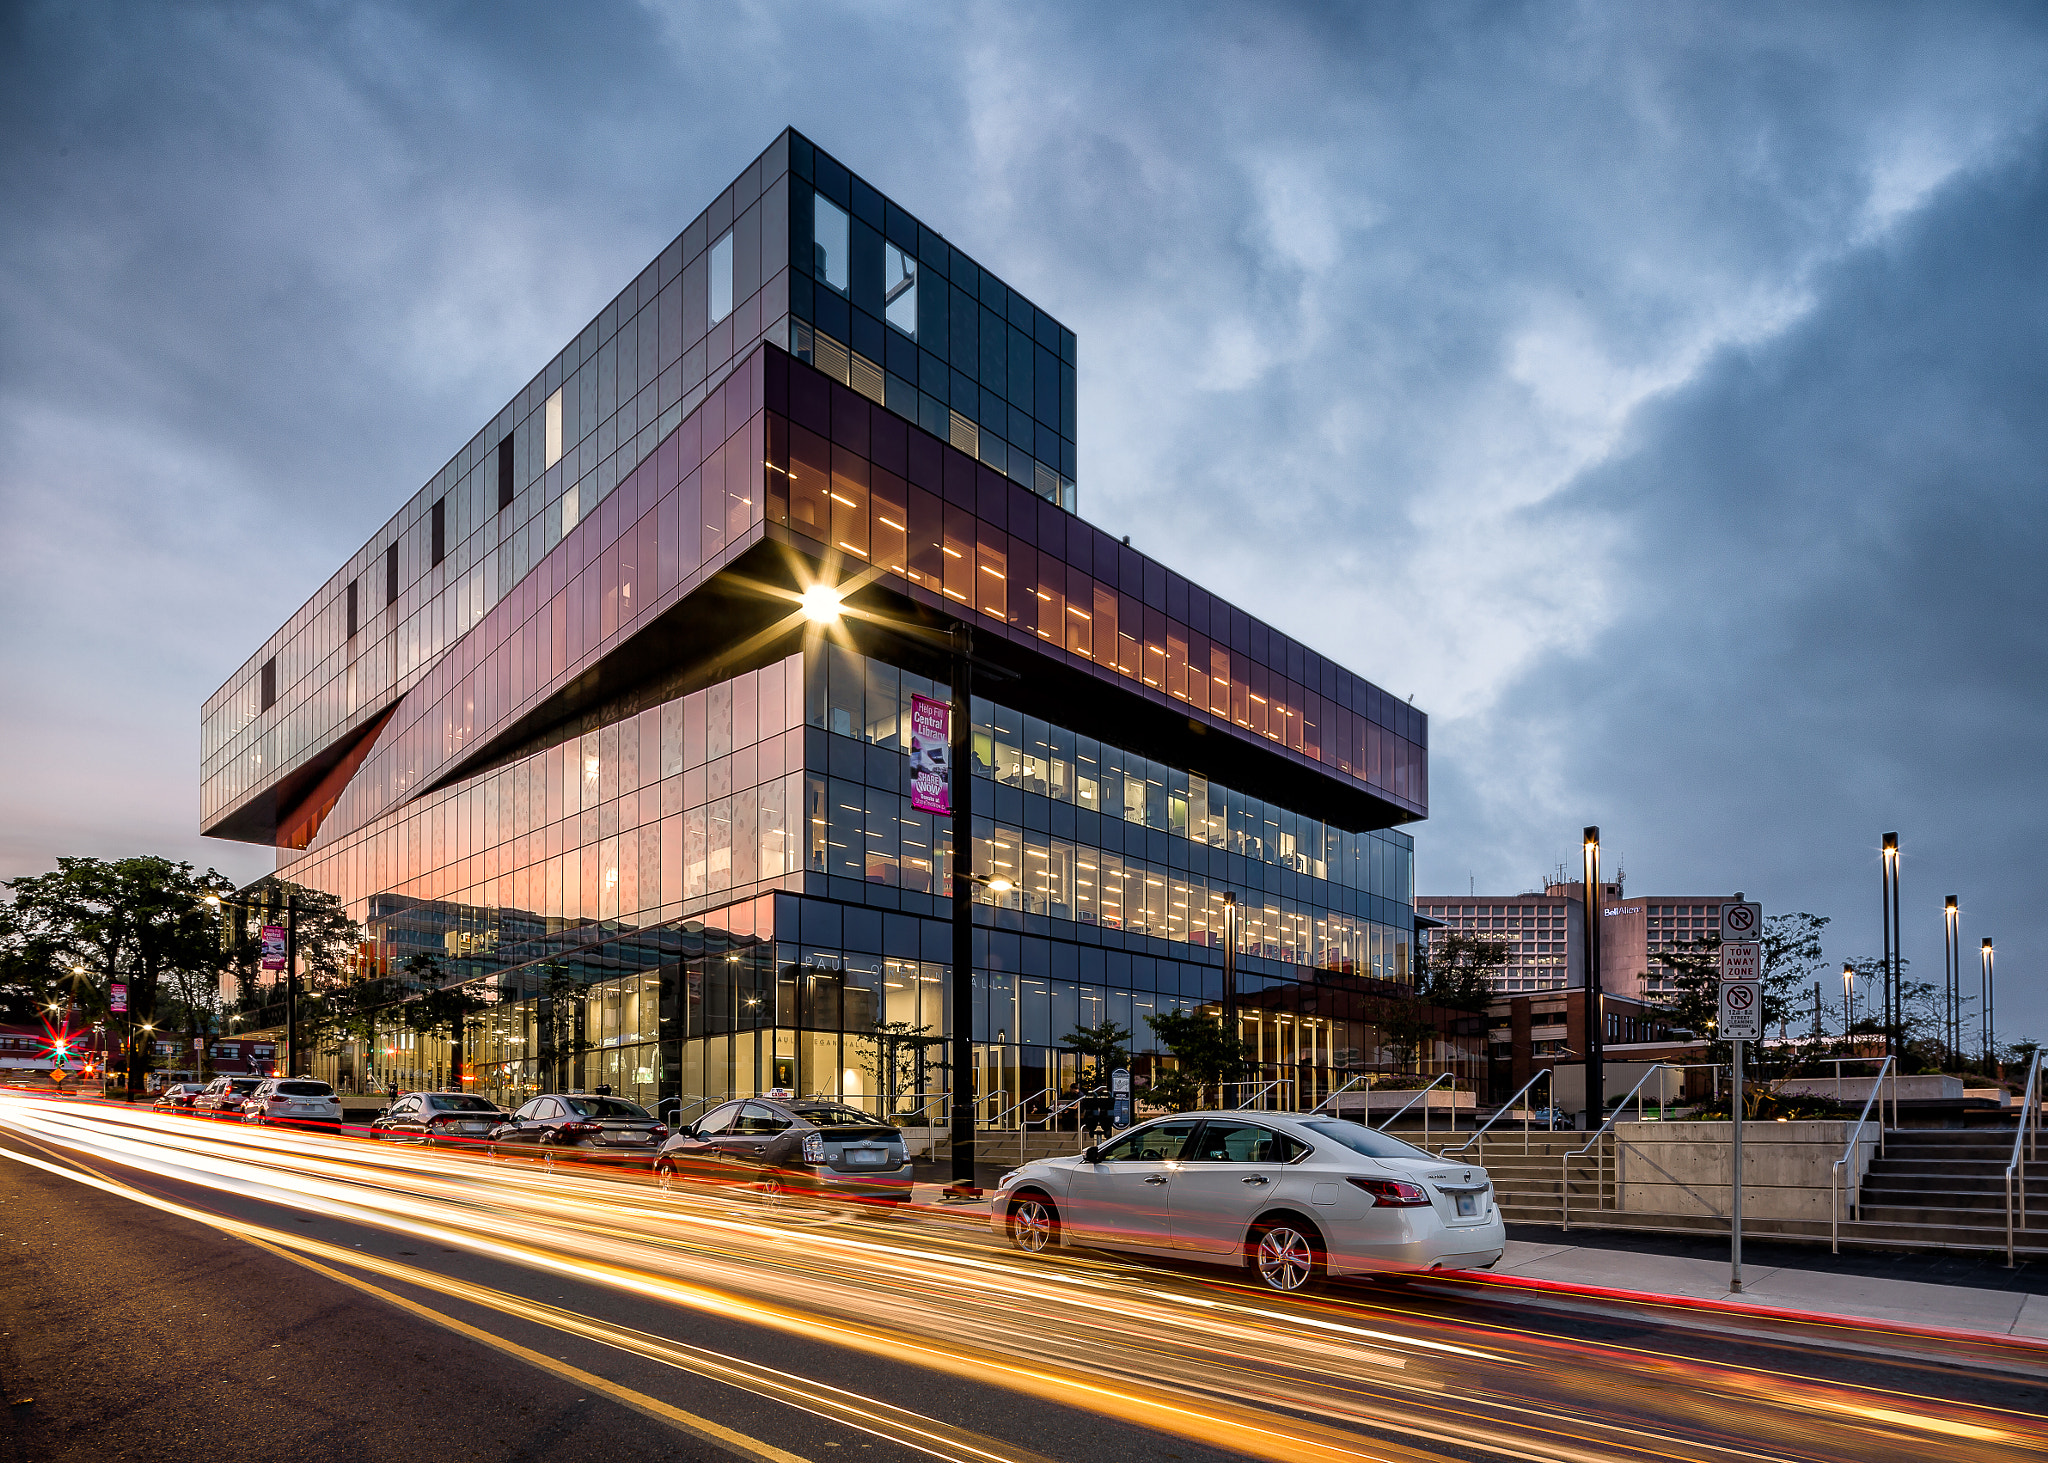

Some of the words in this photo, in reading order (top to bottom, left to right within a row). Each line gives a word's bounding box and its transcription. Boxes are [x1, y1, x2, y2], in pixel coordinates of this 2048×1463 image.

[918, 702, 932, 714] Help
[914, 711, 943, 730] Central
[918, 724, 946, 741] Library
[918, 771, 940, 785] SHARE
[917, 781, 941, 796] WOW
[1730, 948, 1751, 956] TOW
[805, 955, 850, 973] PAUL
[1727, 958, 1755, 966] AWAY
[1728, 967, 1753, 976] ZONE
[776, 1036, 794, 1044] AUL
